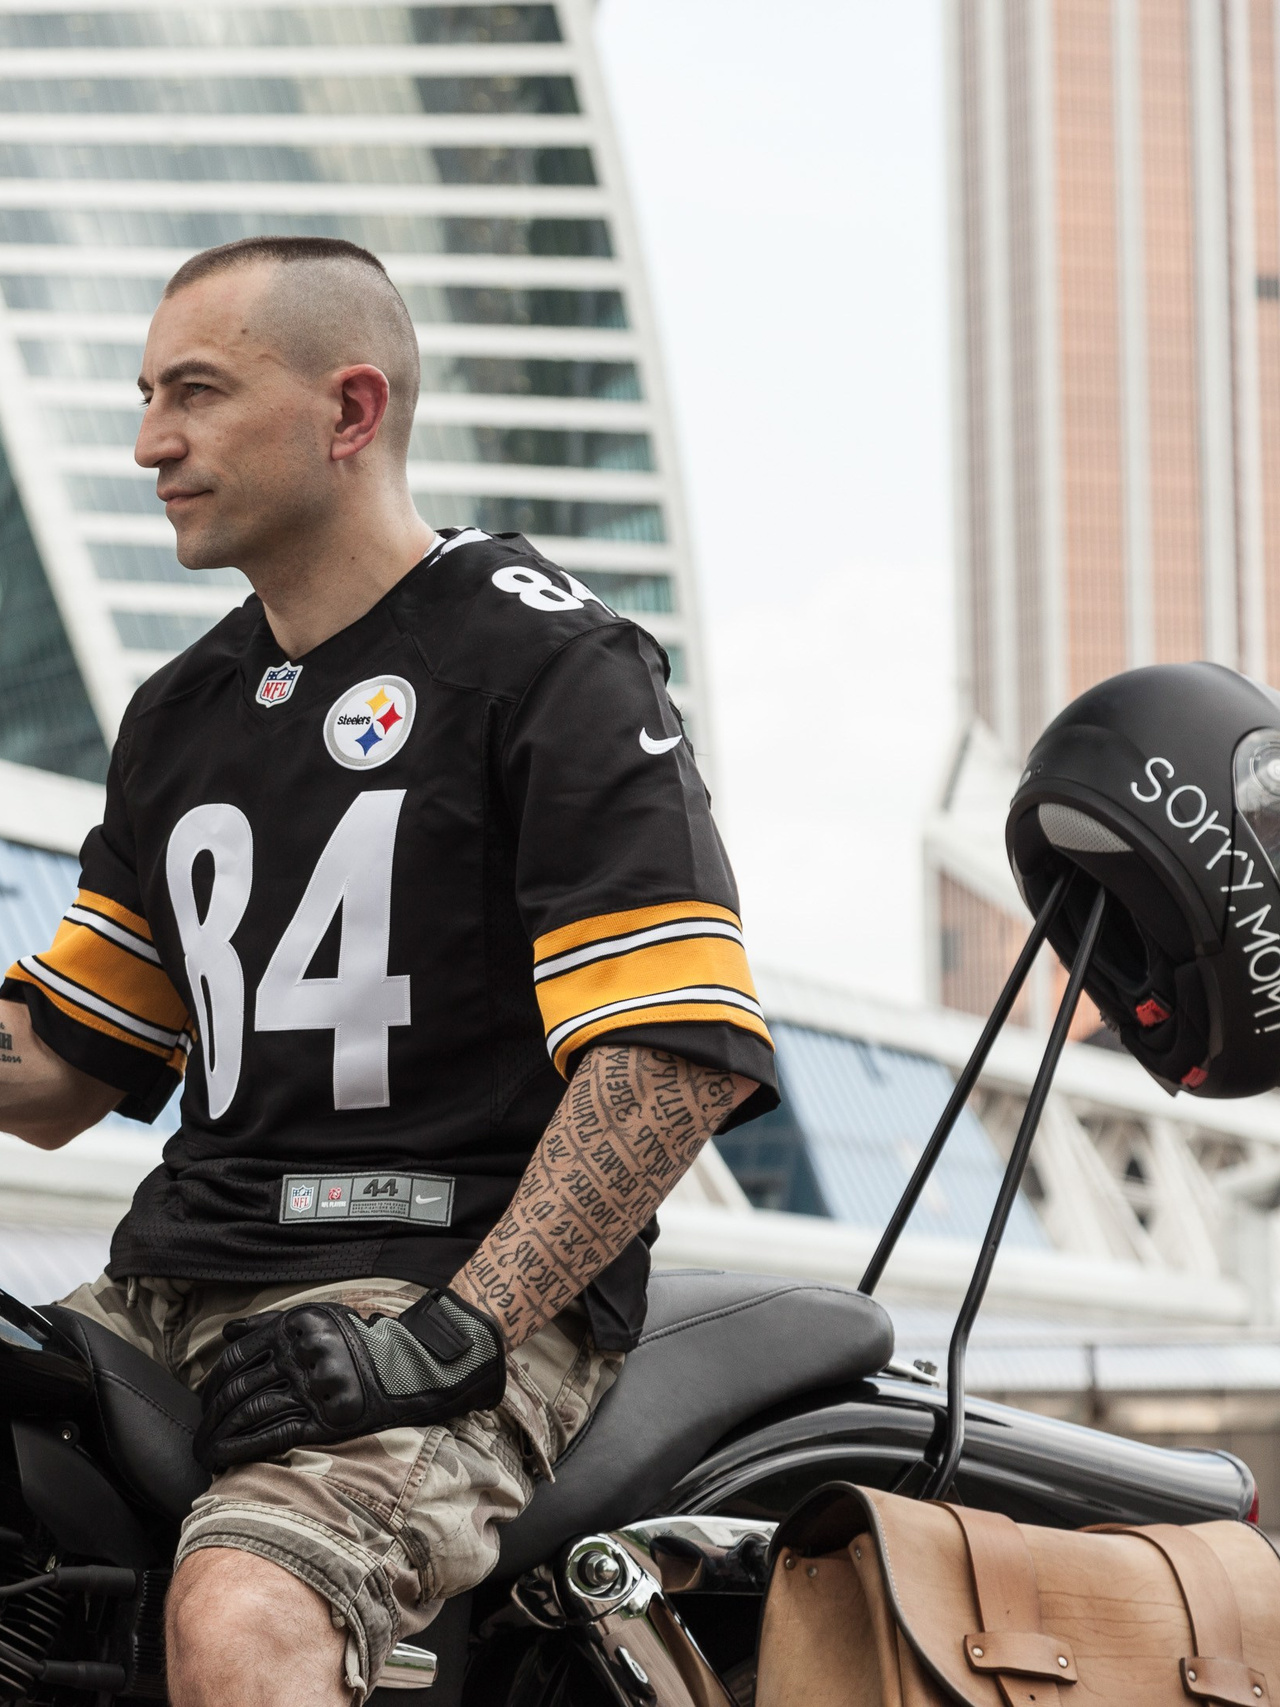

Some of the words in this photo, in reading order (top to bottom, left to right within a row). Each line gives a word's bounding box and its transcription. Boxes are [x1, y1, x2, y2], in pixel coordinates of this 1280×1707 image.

[262, 682, 287, 698] NFL
[337, 714, 371, 726] Steelers
[166, 789, 412, 1120] 84
[363, 1178, 399, 1197] 44
[293, 1197, 308, 1208] NFL
